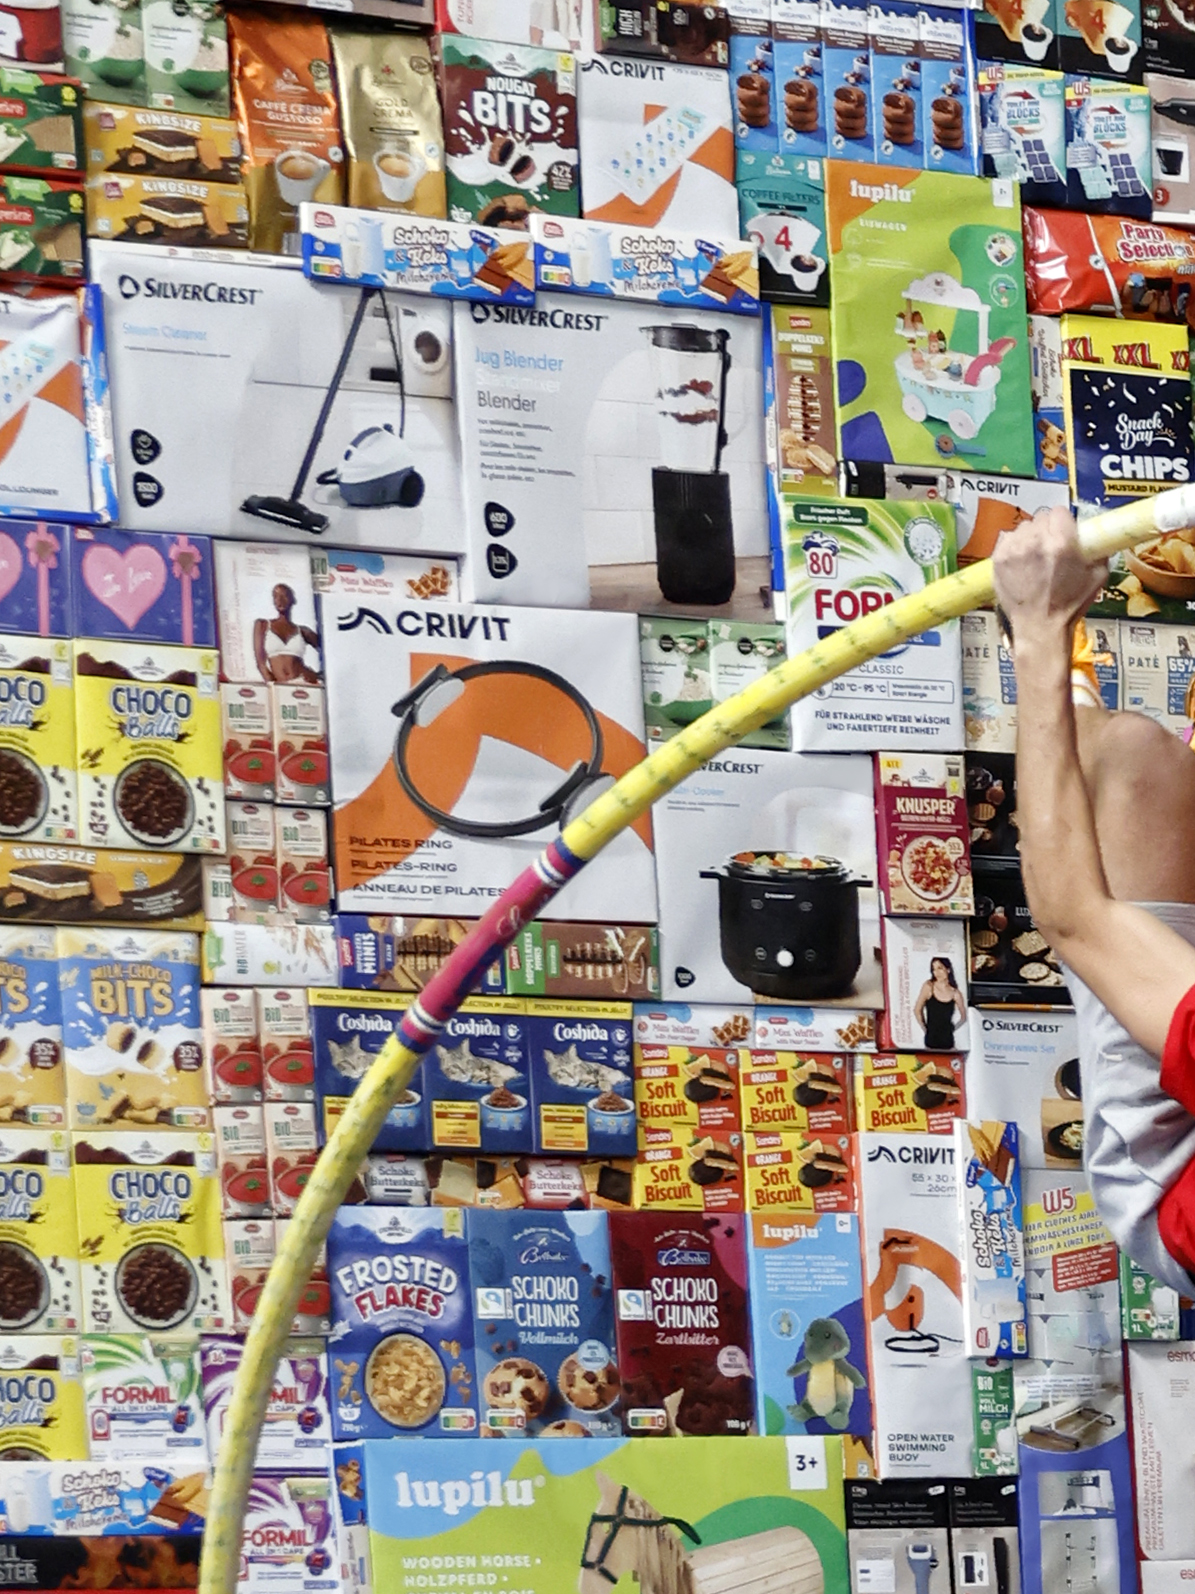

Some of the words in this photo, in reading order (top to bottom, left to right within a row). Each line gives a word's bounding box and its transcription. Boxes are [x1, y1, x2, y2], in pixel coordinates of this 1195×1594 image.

[610, 61, 664, 82] CRIVIT
[486, 76, 536, 98] NOUGAT
[473, 91, 550, 135] BITS
[850, 179, 911, 202] lupilu
[394, 227, 449, 246] Schoko
[775, 227, 791, 251] 4
[1122, 223, 1163, 244] Party
[621, 236, 674, 256] Schoko
[475, 348, 499, 369] Jug
[504, 351, 563, 371] Blender
[1112, 342, 1160, 369] XXL
[477, 391, 536, 412] Blender
[1116, 411, 1164, 434] Snack
[1119, 430, 1153, 450] Day
[1100, 454, 1190, 481] CHIPS
[977, 480, 1020, 497] CRIVIT
[809, 551, 834, 576] 80
[396, 611, 510, 641] CRIVIT
[859, 664, 904, 674] CLASSIC
[1129, 655, 1160, 669] PATÉ
[111, 686, 192, 719] CHOCO
[124, 713, 180, 739] Balls
[827, 723, 844, 731] UND
[900, 726, 939, 735] REINHEIT
[896, 797, 956, 816] KNUSPER
[349, 837, 411, 849] PILATES
[414, 838, 452, 850] RING
[12, 847, 96, 865] KINGSIZE
[351, 860, 457, 873] PILATES-RING
[353, 882, 415, 895] ANNEAU
[418, 885, 441, 896] DE
[92, 978, 174, 1018] BITS
[339, 1014, 392, 1034] Coshida
[554, 1023, 609, 1044] Coshida
[646, 1082, 676, 1101] Soft
[756, 1088, 786, 1106] Soft
[878, 1090, 906, 1108] Soft
[640, 1096, 688, 1120] Biscuit
[872, 1103, 917, 1126] Biscuit
[650, 1164, 681, 1183] Soft
[111, 1171, 191, 1200] CHOCO
[645, 1179, 692, 1202] Biscuit
[124, 1198, 180, 1224] Balls
[763, 1224, 818, 1241] lupilu
[336, 1255, 458, 1293] FROSTED
[511, 1277, 578, 1301] SCHOKO
[652, 1278, 717, 1303] SCHOKO
[354, 1284, 445, 1322] FLAKES
[514, 1303, 580, 1328] CHUNKS
[654, 1303, 719, 1329] CHUNKS
[519, 1331, 579, 1346] Vollmilch
[102, 1386, 175, 1403] FORMIL
[978, 1403, 1008, 1414] MILCH
[887, 1433, 916, 1443] OPEN
[918, 1434, 954, 1443] WATER
[888, 1444, 946, 1452] SWIMMING
[795, 1454, 818, 1471] 3+
[62, 1471, 122, 1492] Schoko
[396, 1472, 536, 1516] lupilu
[402, 1556, 477, 1569] WOODEN
[481, 1555, 531, 1568] HORSE
[405, 1572, 497, 1586] HOLZPFERD
